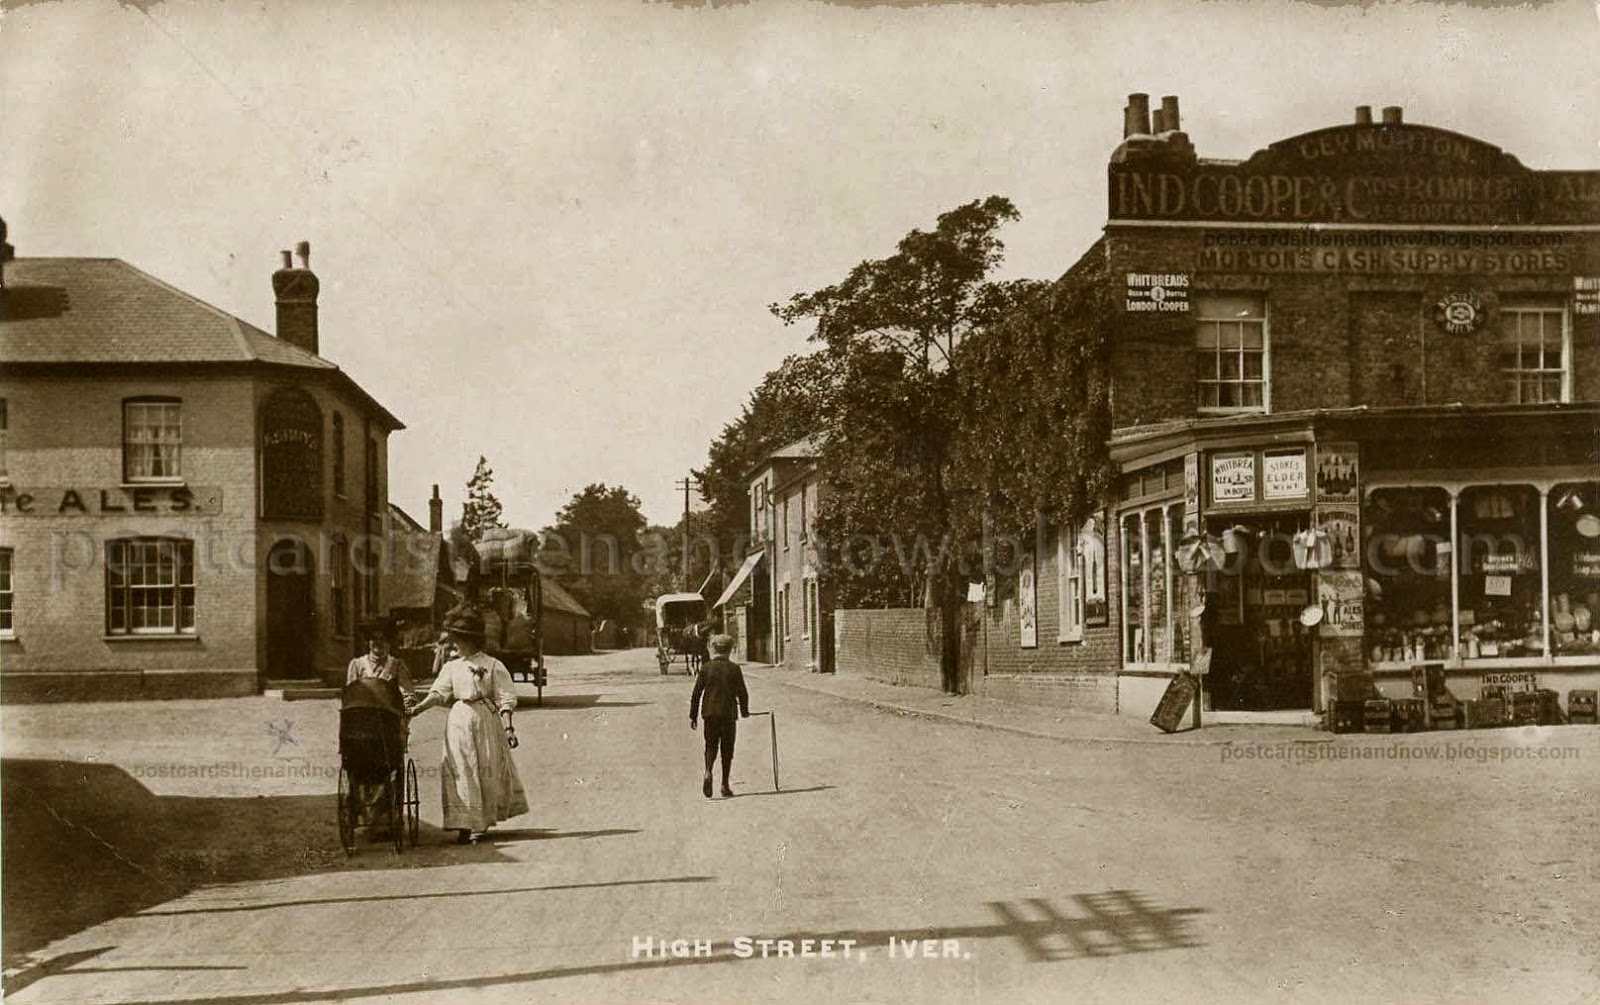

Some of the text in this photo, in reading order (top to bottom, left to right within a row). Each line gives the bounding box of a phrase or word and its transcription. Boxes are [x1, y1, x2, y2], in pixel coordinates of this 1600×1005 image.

[1116, 172, 1185, 216] IND
[1194, 174, 1317, 218] COOPE
[1322, 251, 1381, 270] CASH
[1391, 251, 1474, 271] SUPPLY
[1483, 252, 1568, 272] STORES
[1125, 298, 1190, 312] LONDON COOPER
[1267, 471, 1304, 483] ELDER
[58, 488, 202, 513] ALES.
